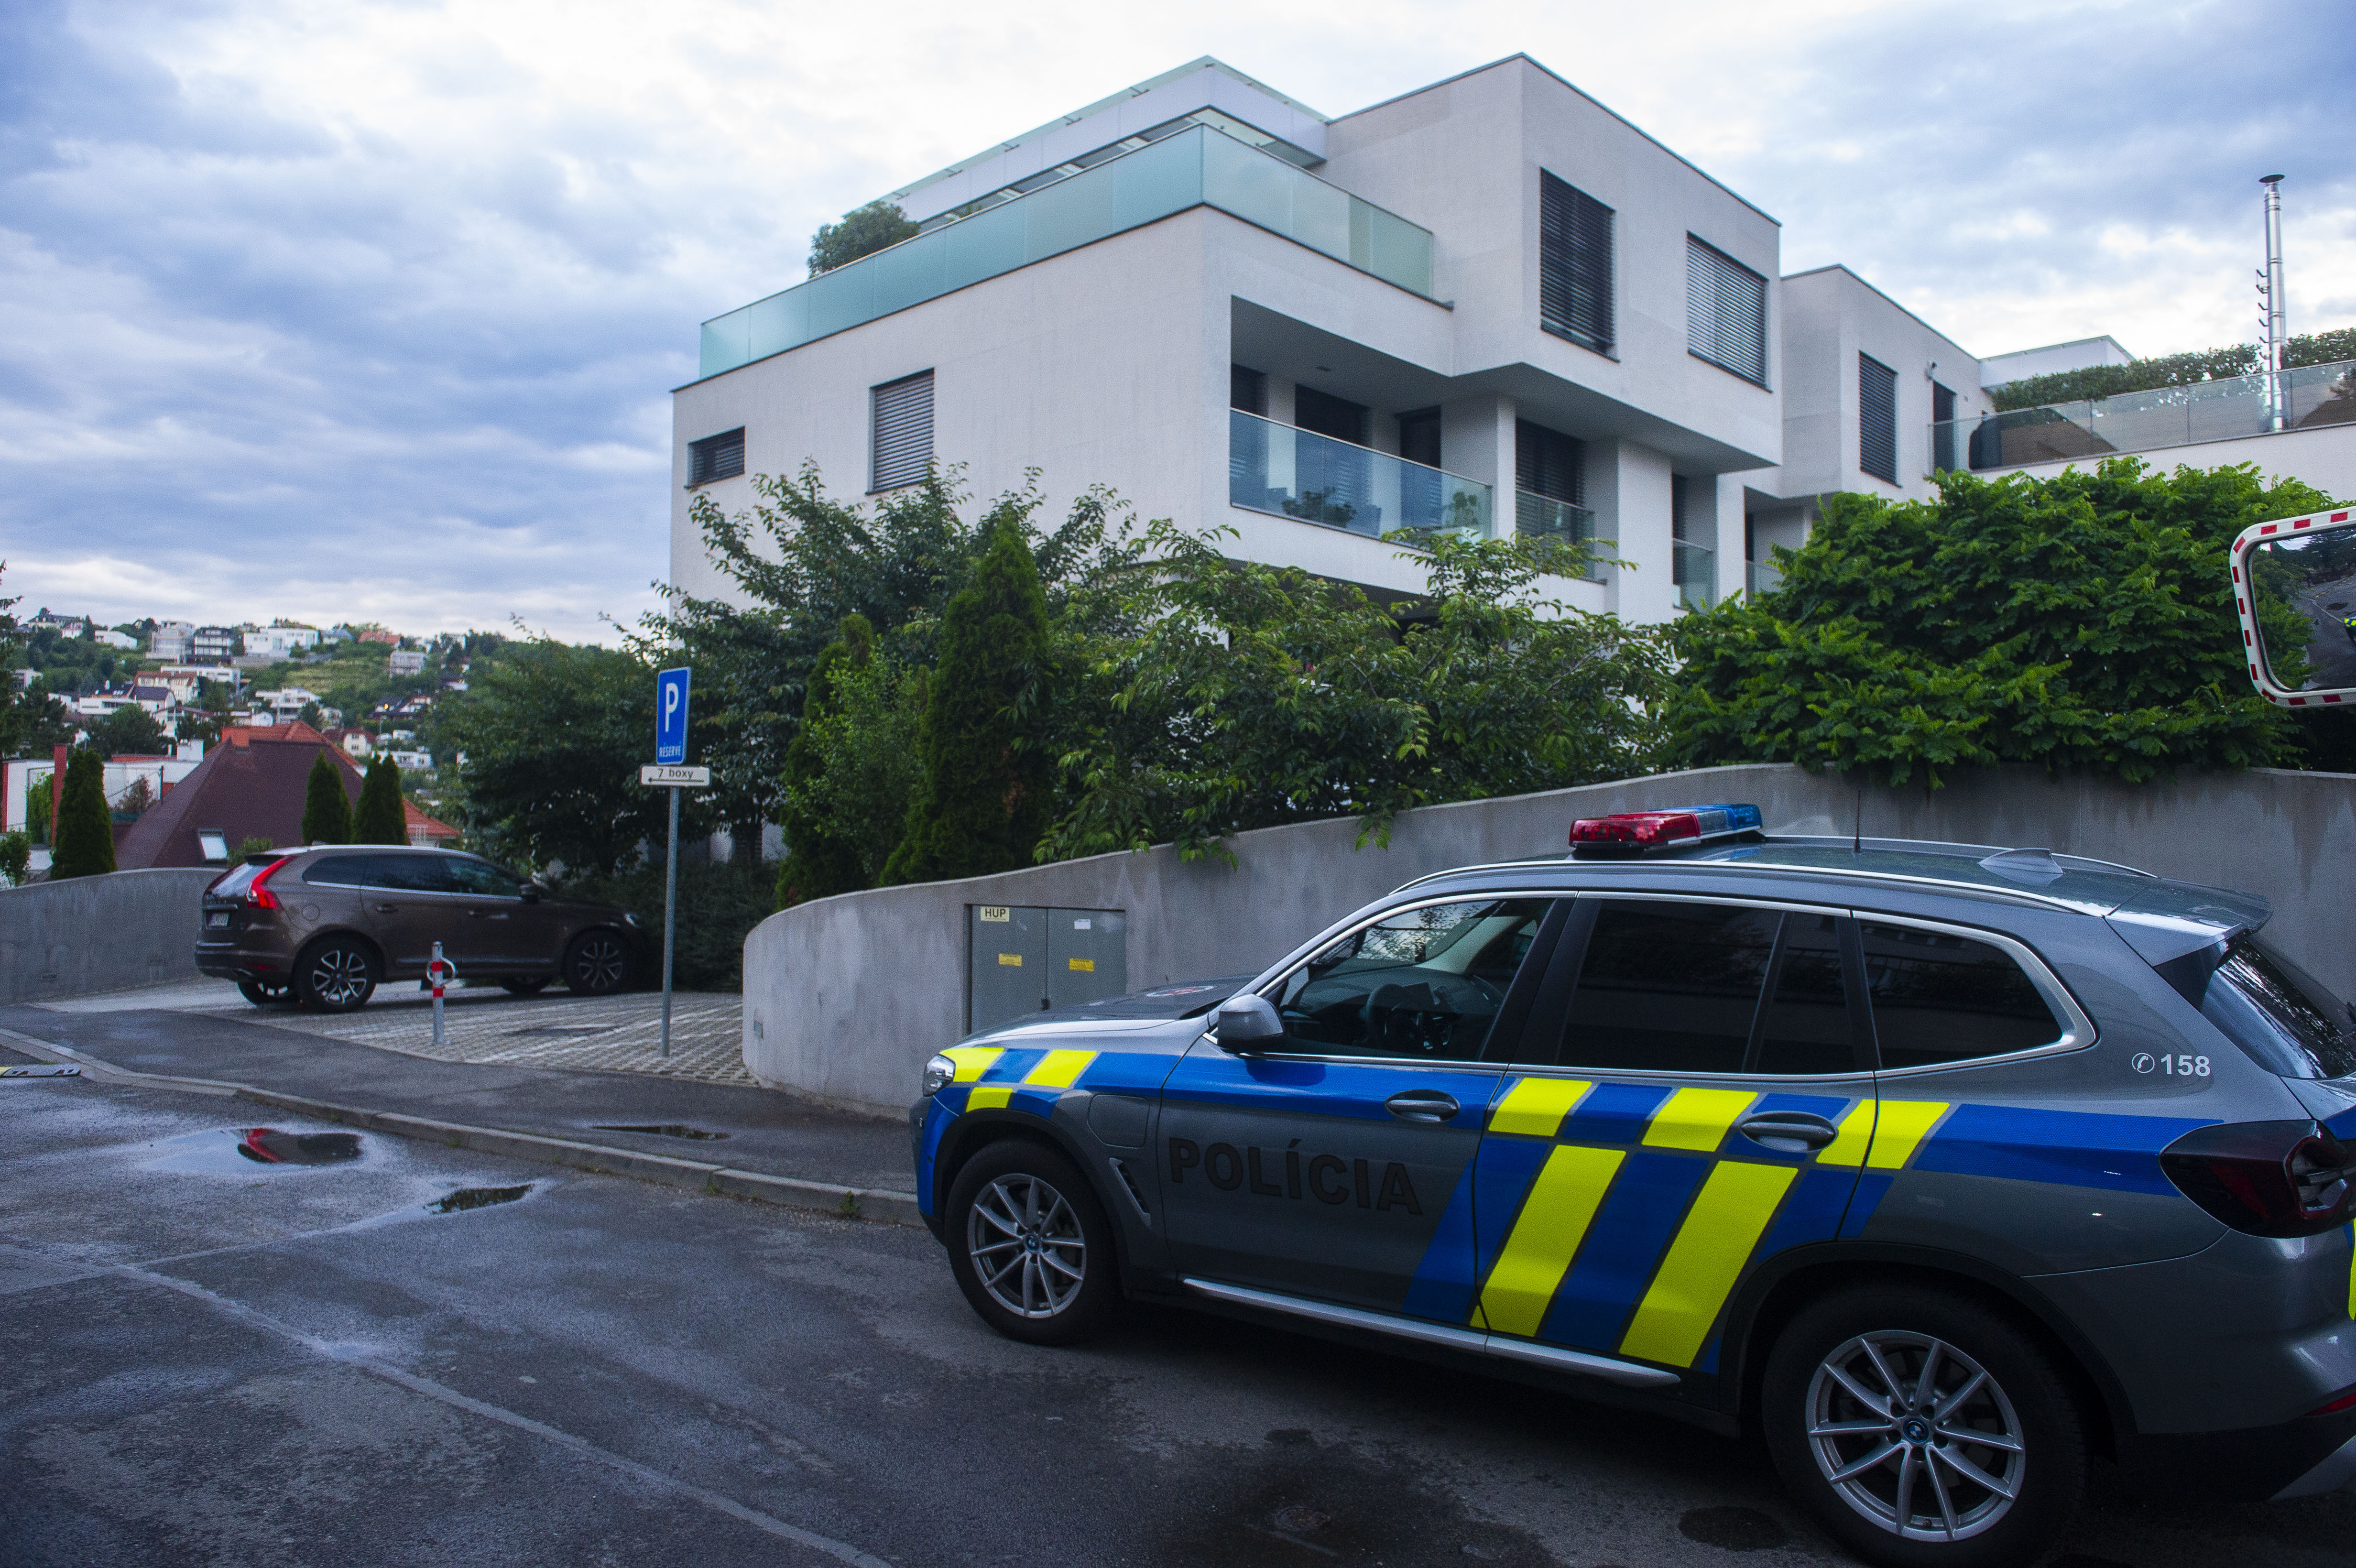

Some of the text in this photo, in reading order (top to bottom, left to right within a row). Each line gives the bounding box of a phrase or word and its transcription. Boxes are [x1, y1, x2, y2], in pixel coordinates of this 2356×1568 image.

[665, 682, 679, 732] P
[658, 768, 694, 780] 7 boxy
[985, 908, 1006, 917] HUP
[2160, 1054, 2211, 1077] 158
[1169, 1137, 1423, 1216] POLÍCIA
